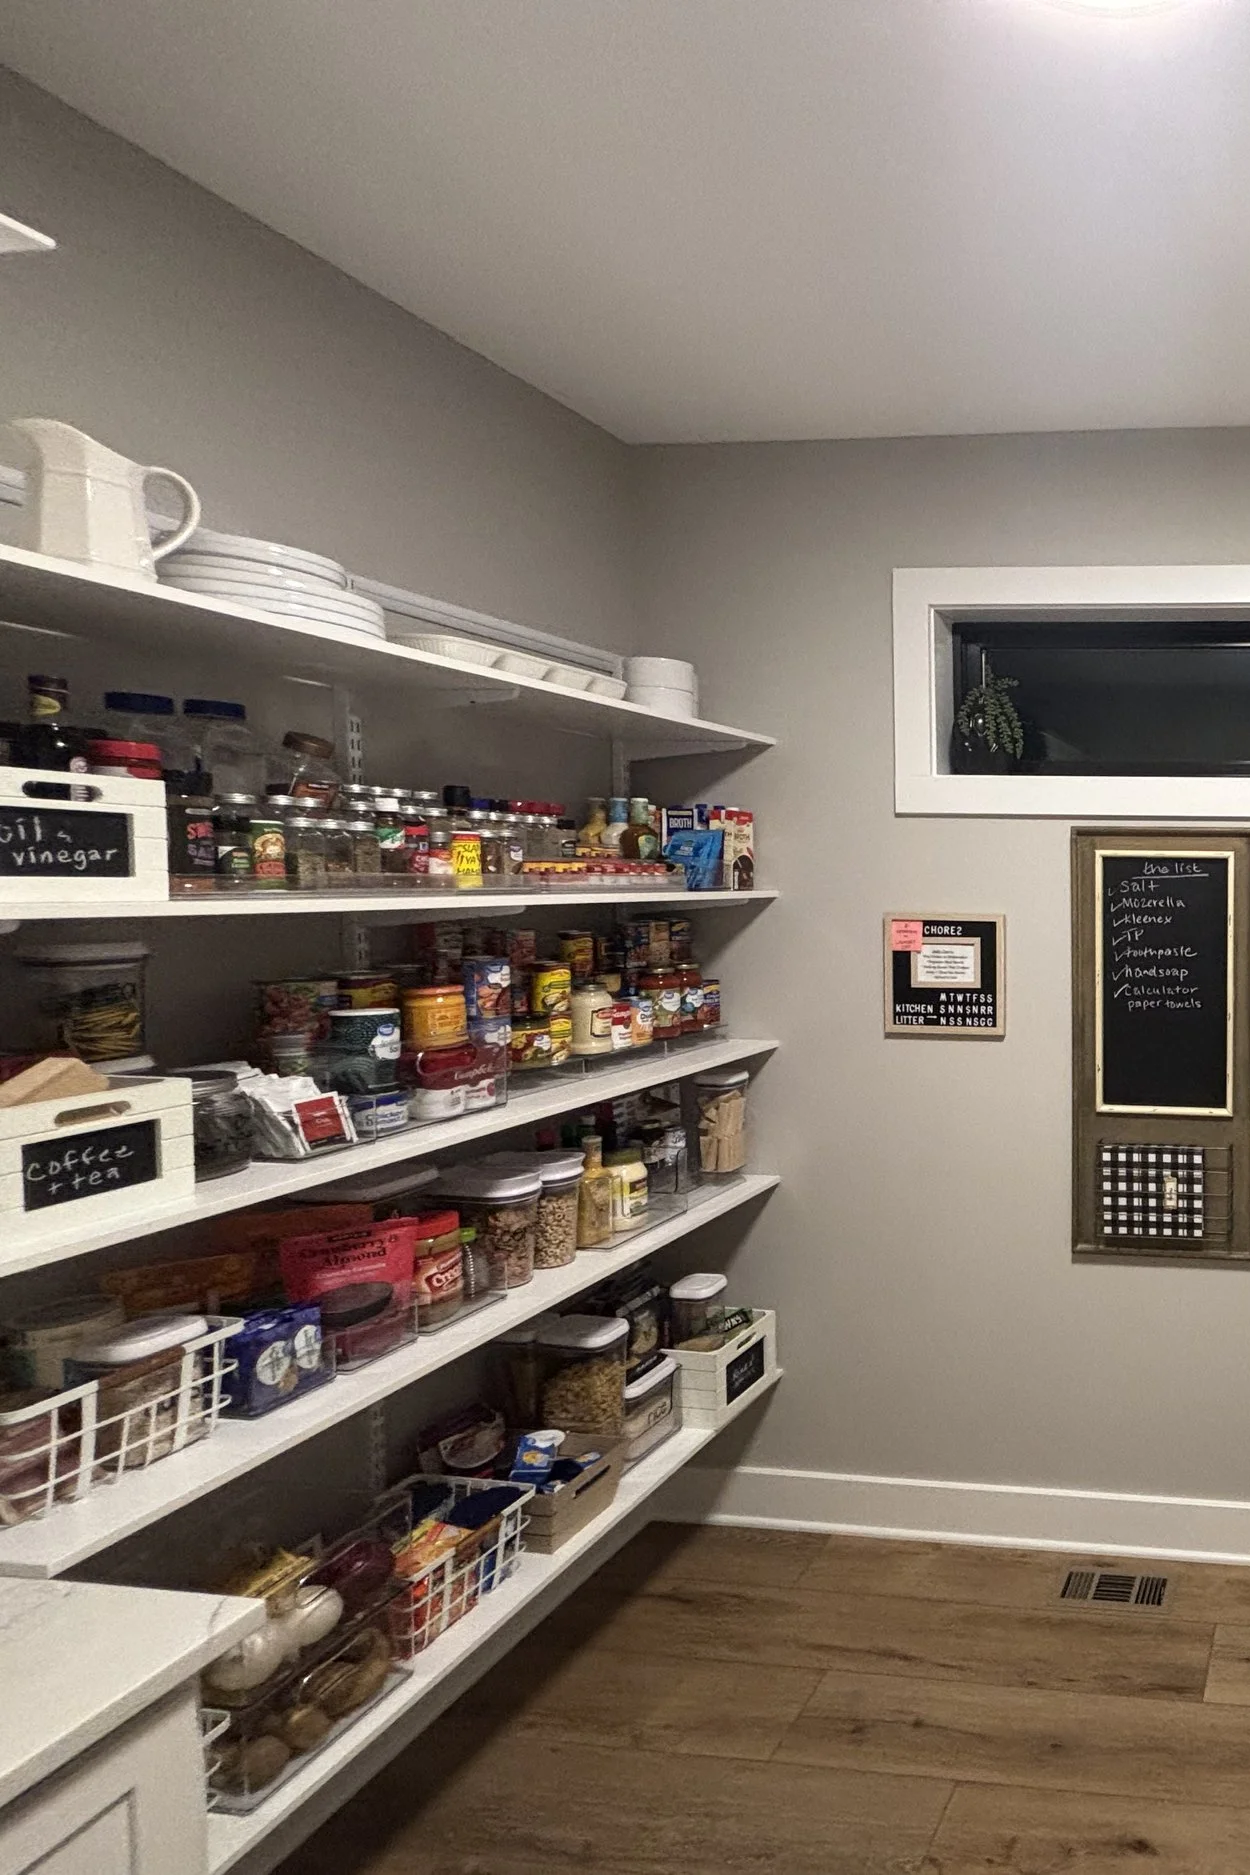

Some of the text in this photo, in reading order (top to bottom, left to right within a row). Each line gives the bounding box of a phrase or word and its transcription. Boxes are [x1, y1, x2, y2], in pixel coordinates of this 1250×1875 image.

[0, 816, 42, 843] oil
[669, 817, 693, 829] BROTH
[12, 846, 118, 870] vinegar
[1143, 862, 1202, 875] the list
[1122, 928, 1144, 941] TP
[1125, 964, 1188, 981] handsoap
[896, 1004, 933, 1013] KITCHEN
[1128, 998, 1202, 1012] paper towels
[896, 1015, 924, 1024] LITTER
[26, 1146, 134, 1181] Coffee
[72, 1167, 120, 1190] tea
